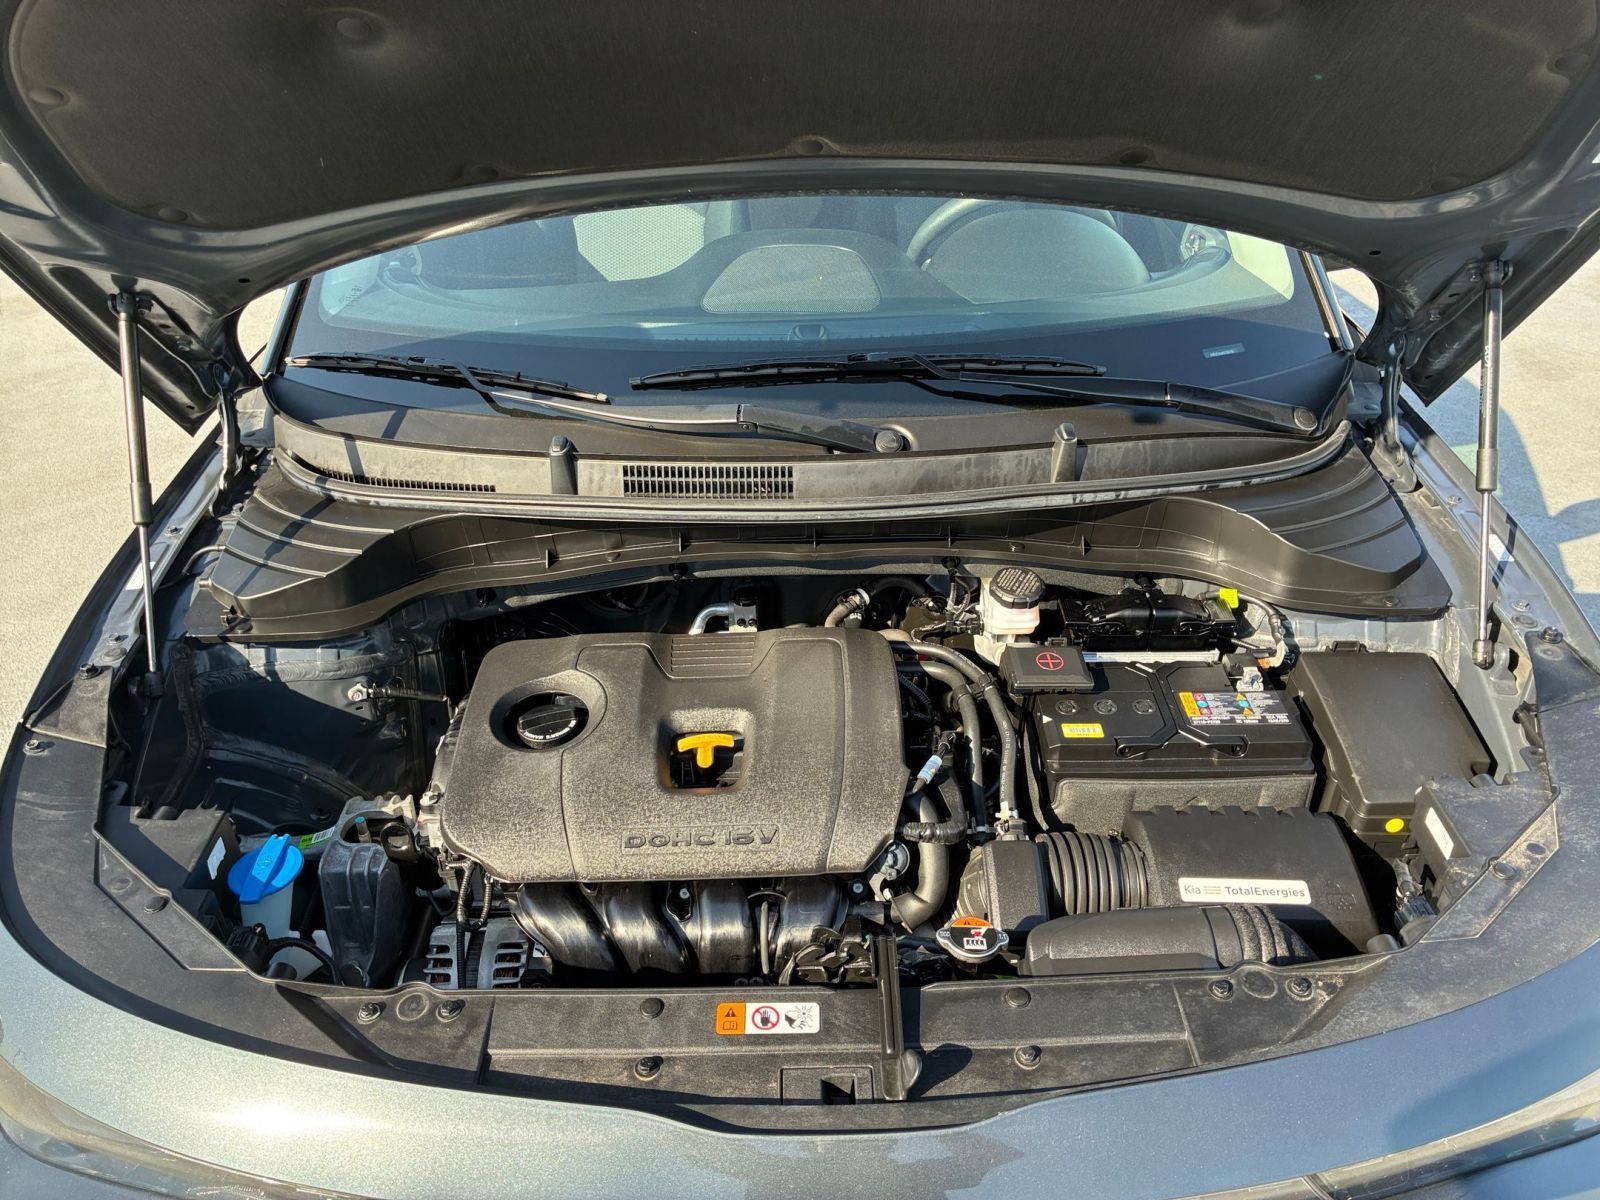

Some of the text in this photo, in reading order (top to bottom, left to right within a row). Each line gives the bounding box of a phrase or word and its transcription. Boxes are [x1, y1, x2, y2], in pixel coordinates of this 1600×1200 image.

[624, 828, 778, 848] DOHC 16V
[1184, 885, 1305, 898] Kia TotalEnergies
